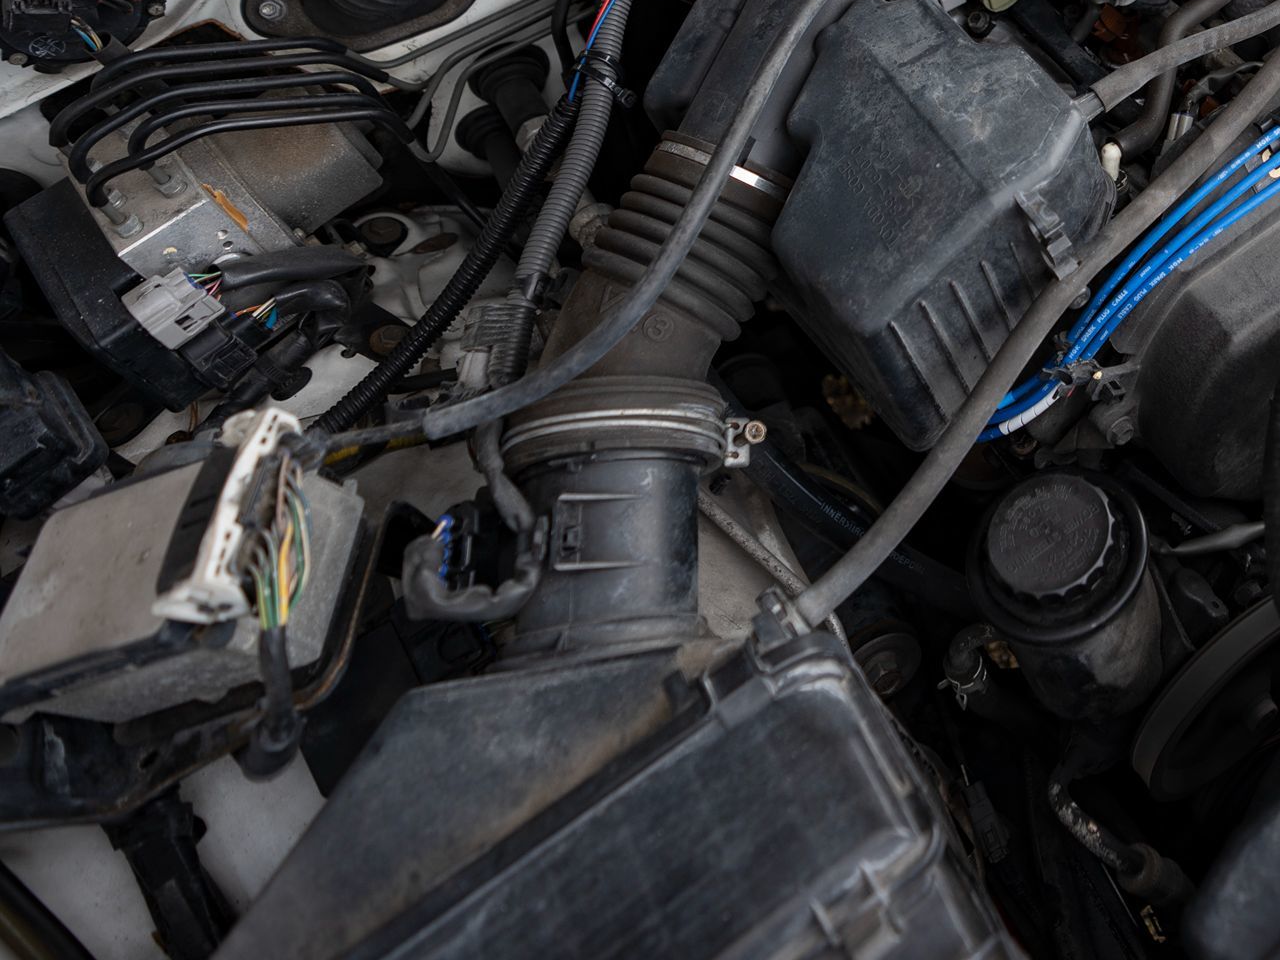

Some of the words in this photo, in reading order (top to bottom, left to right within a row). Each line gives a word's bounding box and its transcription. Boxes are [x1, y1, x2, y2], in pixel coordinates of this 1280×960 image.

[1168, 257, 1184, 271] NGK
[1149, 271, 1166, 288] SPARK
[1133, 288, 1148, 302] PLUG
[1096, 308, 1110, 323] PLUG
[1111, 289, 1129, 307] CABLE
